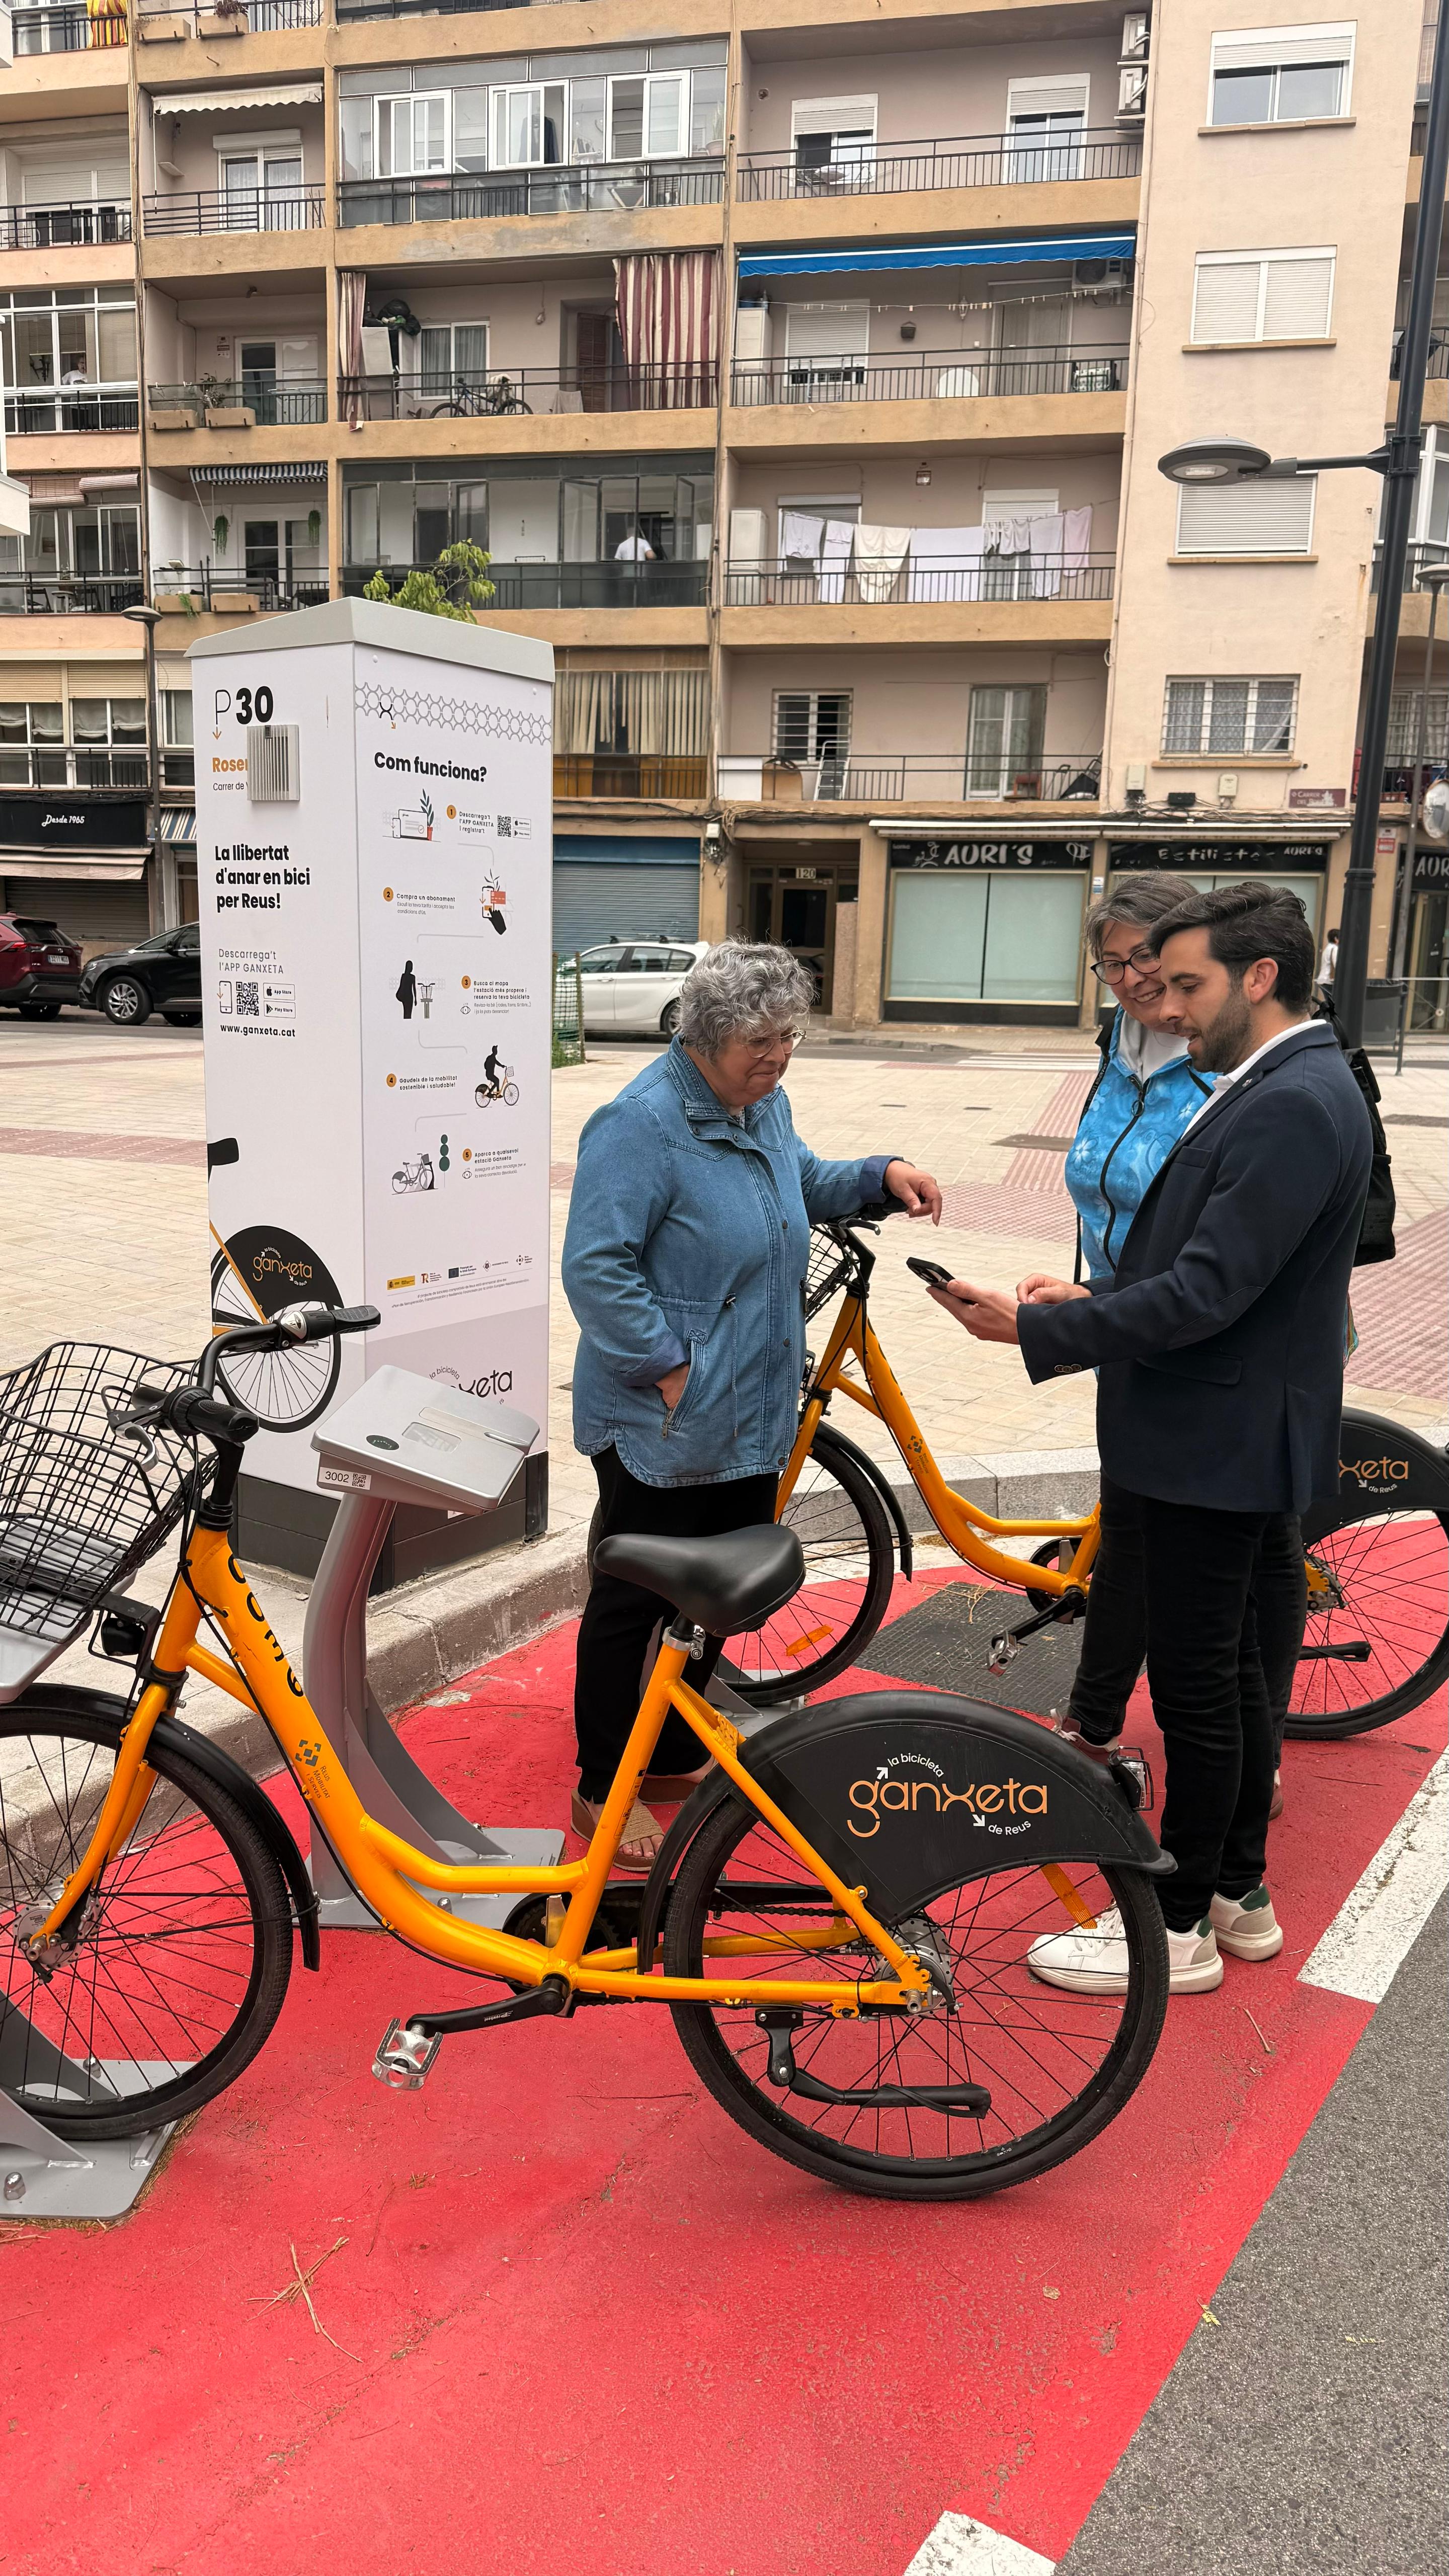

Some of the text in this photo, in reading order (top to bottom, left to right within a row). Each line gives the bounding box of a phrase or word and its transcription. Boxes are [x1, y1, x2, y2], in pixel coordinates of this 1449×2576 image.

[374, 752, 487, 782] Com funciona?
[213, 782, 234, 791] Carrer
[235, 782, 245, 790] de
[41, 814, 85, 827] Desde 1965
[214, 843, 289, 861] La llibertat
[944, 843, 1033, 865] AURI'S
[215, 867, 310, 885] d'anar en bici
[797, 868, 816, 878] 120
[217, 893, 281, 913] per Reus!
[218, 948, 277, 962] Descarrega't
[219, 962, 284, 974] l'APP GANXETA
[220, 1024, 296, 1037] www.ganxeta.cat
[253, 1256, 312, 1281] ganxeta
[429, 1365, 460, 1380] la bicicleta
[1338, 1456, 1409, 1480] xeta
[325, 1471, 350, 1483] 3002
[1368, 1483, 1397, 1493] de Reus
[887, 1752, 944, 1778] la bicicleta
[847, 1778, 1048, 1838] ganxeta
[988, 1820, 1032, 1836] de Reus
